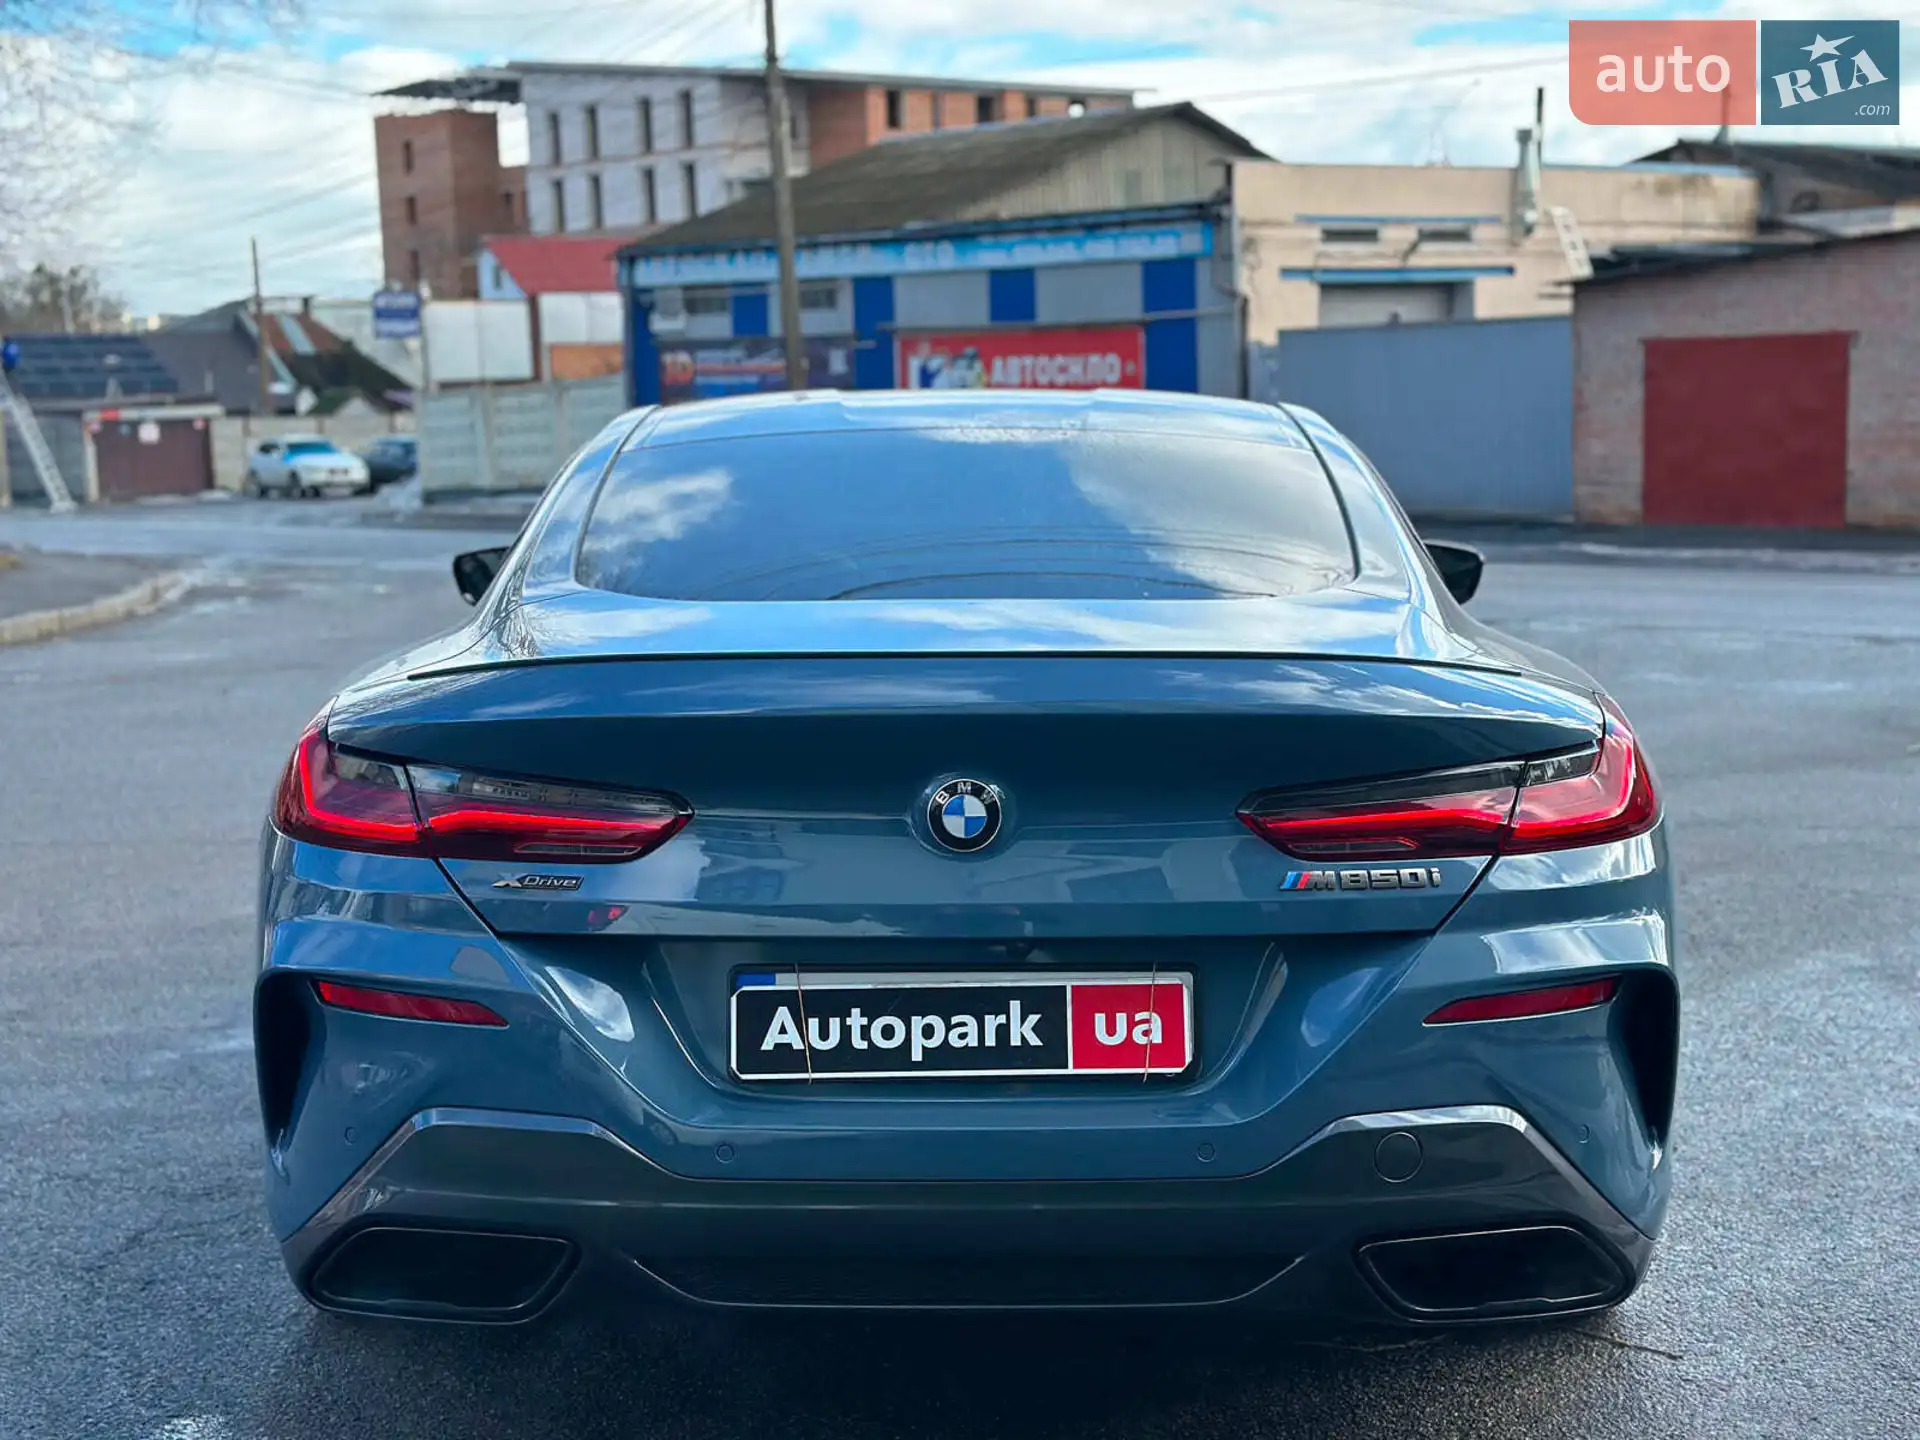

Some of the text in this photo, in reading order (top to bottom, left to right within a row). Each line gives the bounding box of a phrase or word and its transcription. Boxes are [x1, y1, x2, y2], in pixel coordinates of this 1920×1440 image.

[935, 782, 996, 804] BMW
[760, 1000, 1163, 1061] Autopark ua
